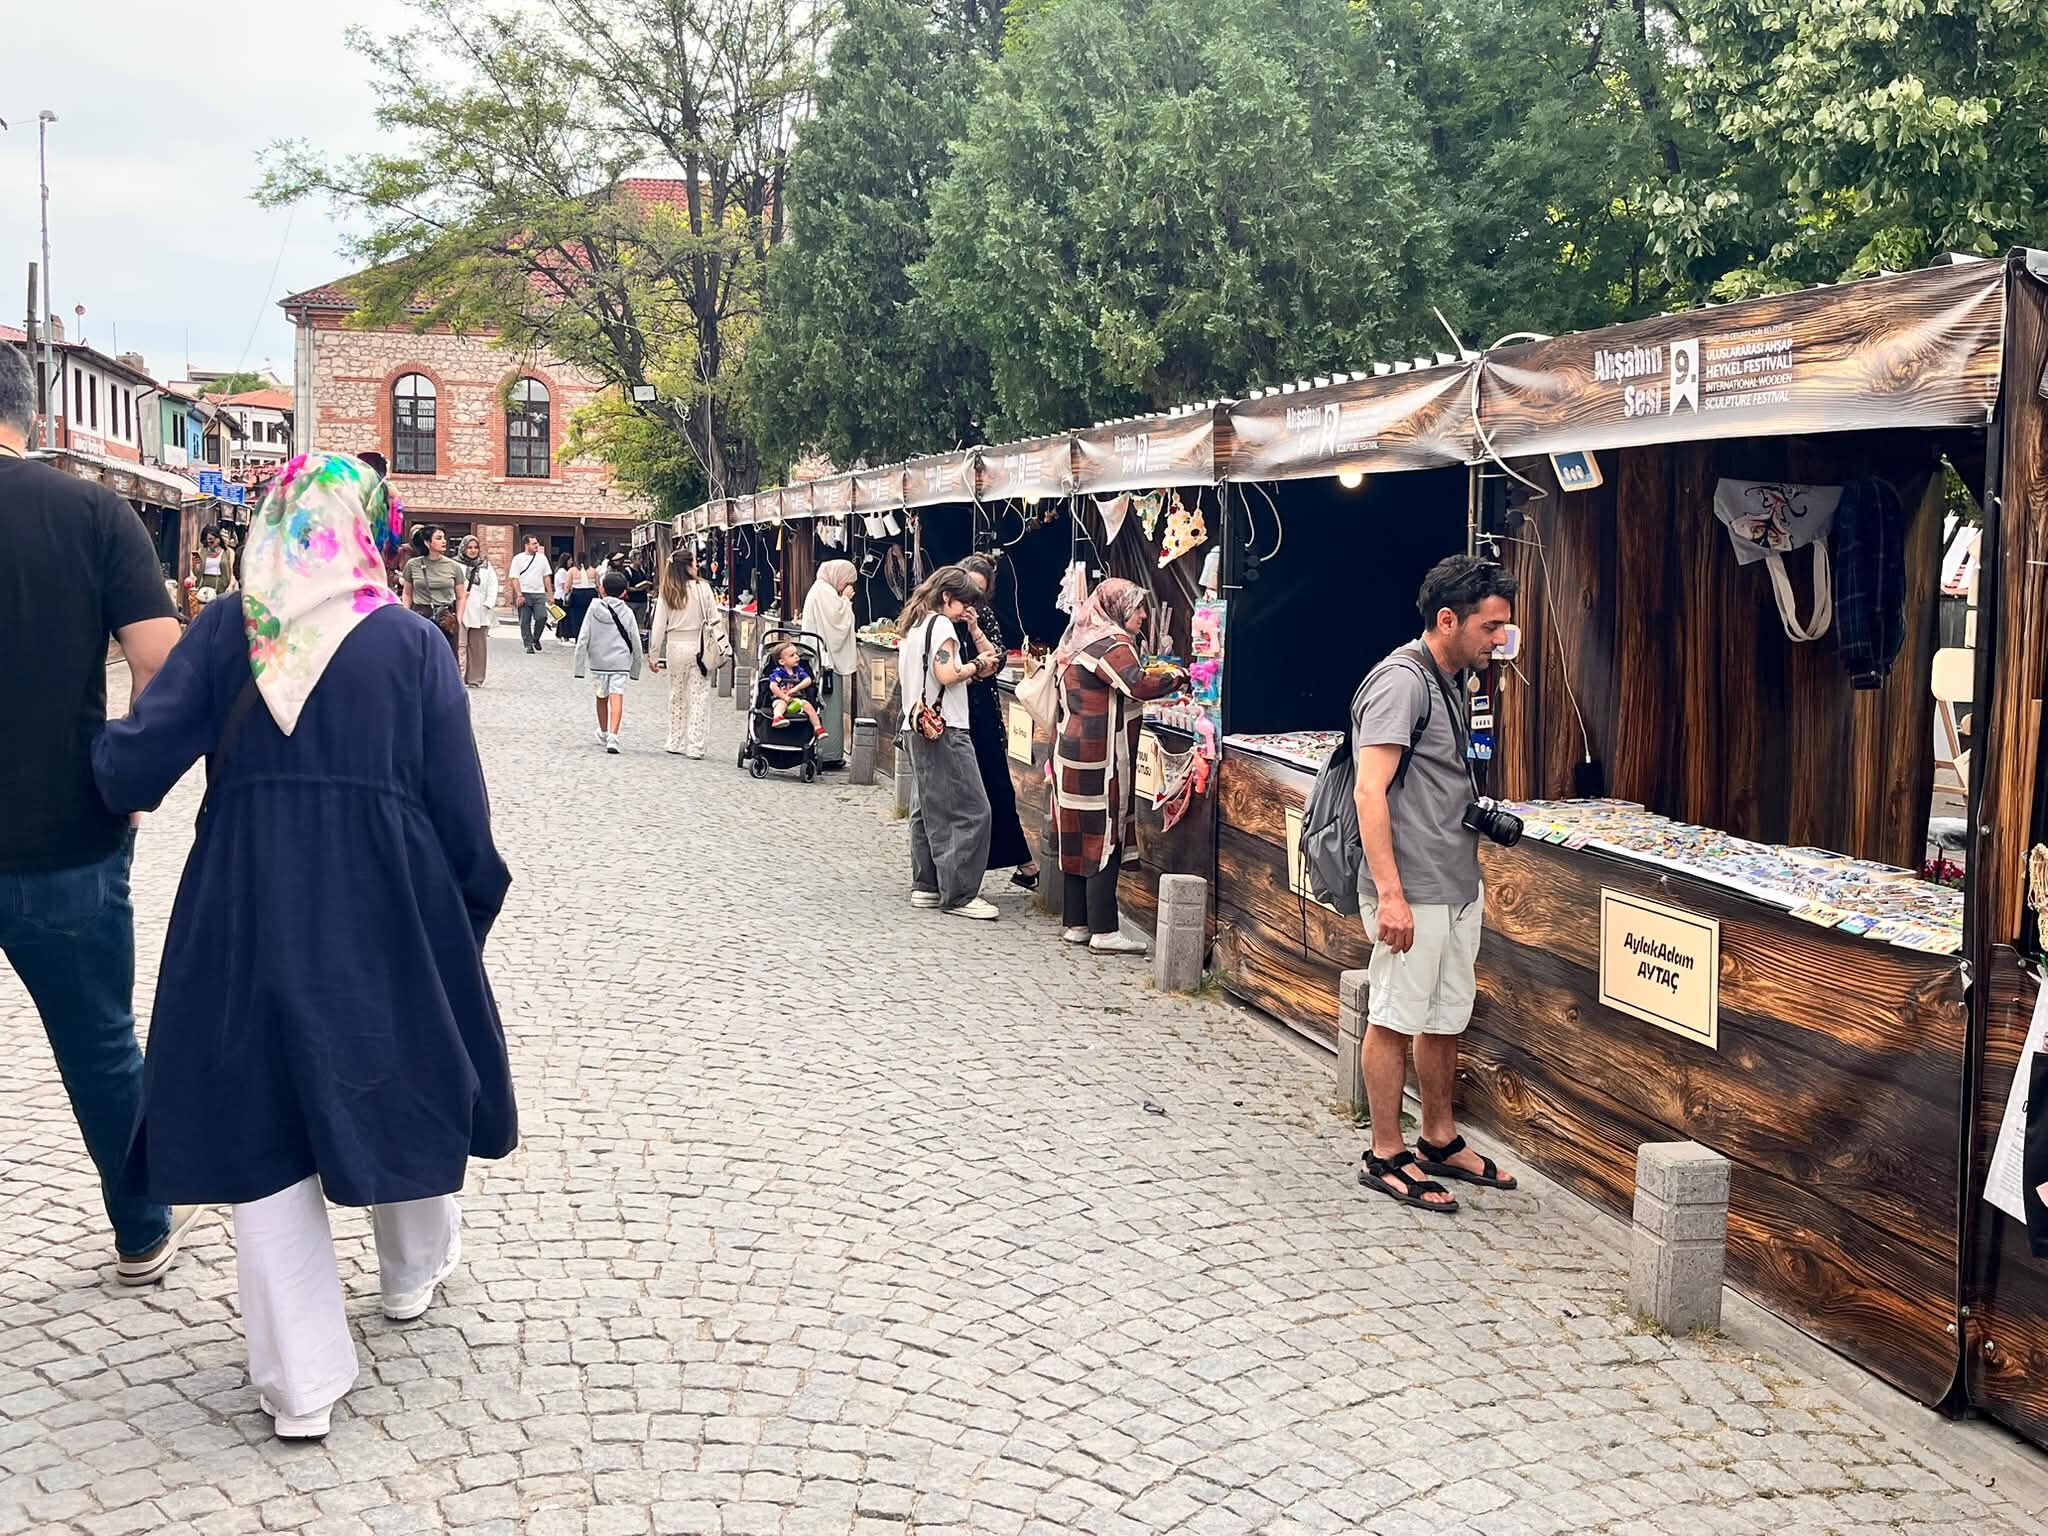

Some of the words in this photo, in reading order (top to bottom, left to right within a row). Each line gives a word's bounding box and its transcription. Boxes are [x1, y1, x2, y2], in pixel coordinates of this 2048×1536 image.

[1595, 345, 1663, 384] Ahşabın
[1705, 361, 1743, 379] HEYKEL
[1743, 351, 1793, 374] FESTİVALİ
[1706, 344, 1765, 361] ULUSLARARASI
[1765, 338, 1793, 353] AHŞAP
[1705, 377, 1758, 393] INTERNATIONAL
[1758, 373, 1793, 387] WOODEN
[1624, 383, 1662, 417] Sesi
[1704, 393, 1752, 411] SCULPTURE
[1752, 390, 1790, 407] FESTIVAL
[1623, 932, 1694, 971] AylakAdam
[1637, 961, 1680, 995] AYTAÇ
